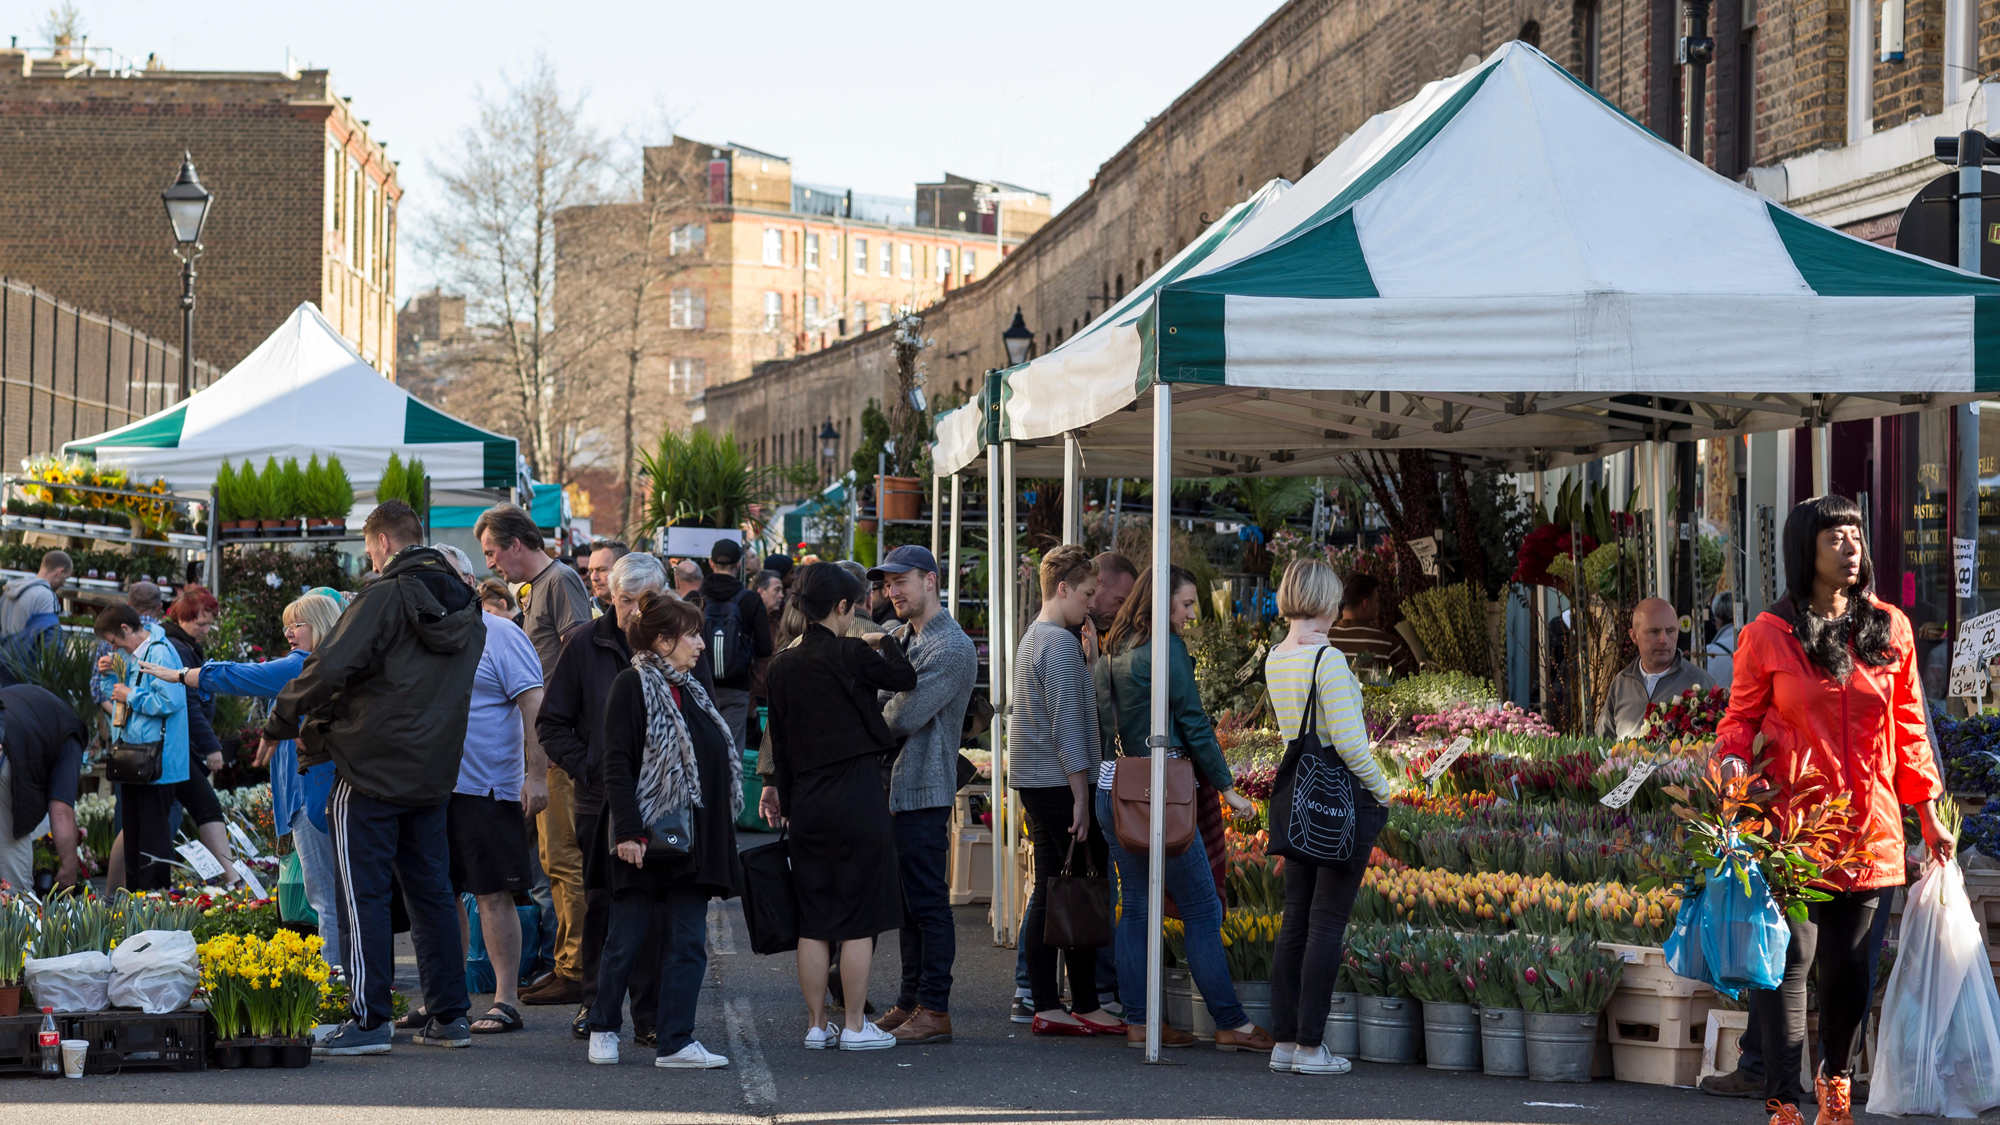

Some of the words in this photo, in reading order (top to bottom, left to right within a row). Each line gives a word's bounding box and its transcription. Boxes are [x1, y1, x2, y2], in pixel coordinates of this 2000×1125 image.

[1917, 463, 1939, 483] CAKES
[1925, 485, 1930, 500] &
[1914, 504, 1943, 519] PASTRIES
[1904, 529, 1915, 545] HOT
[1917, 529, 1947, 544] CHOCOLAT
[1906, 550, 1918, 565] TEA
[1918, 550, 1924, 565] &
[1307, 799, 1347, 817] MOGWAI
